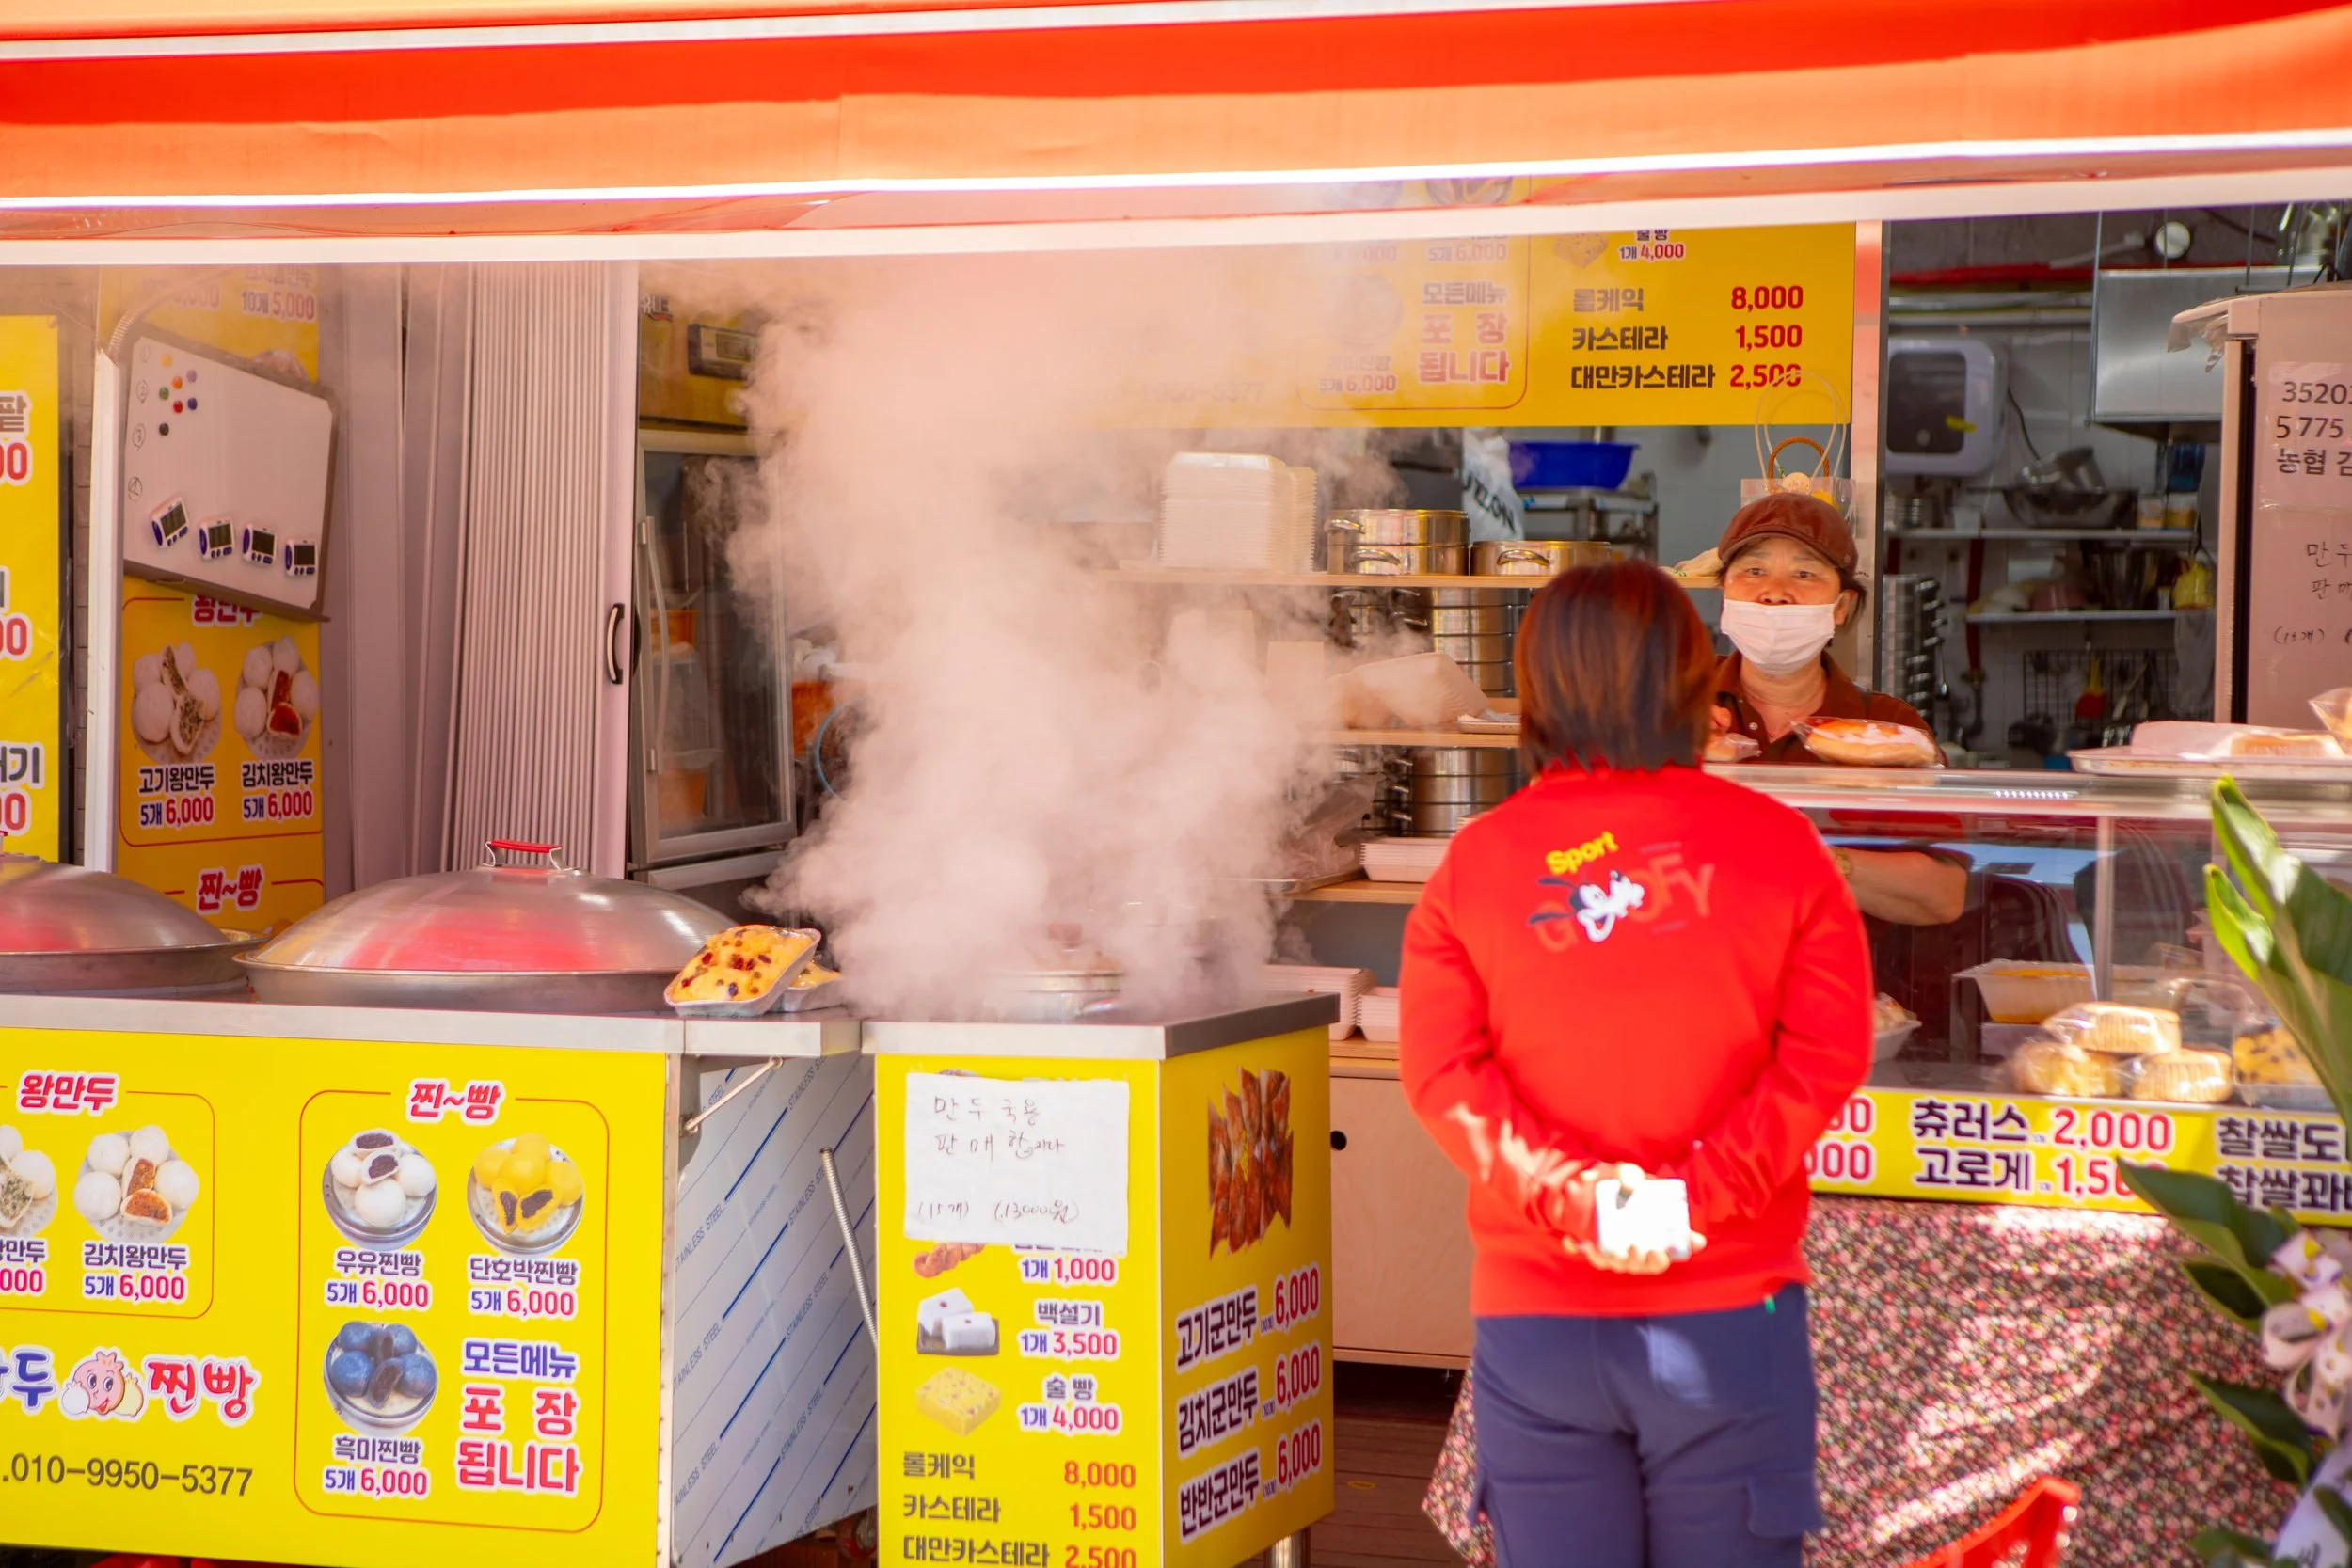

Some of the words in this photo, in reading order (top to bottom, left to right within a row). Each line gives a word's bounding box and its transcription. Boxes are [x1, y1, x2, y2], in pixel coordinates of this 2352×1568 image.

[1640, 244, 1685, 261] 4,000
[272, 292, 315, 321] 5,000
[1422, 283, 1506, 305] 모든메뉴
[1572, 288, 1645, 312] 롤케익
[1731, 285, 1804, 313] 8,000
[1572, 326, 1669, 352] 카스테라
[1735, 325, 1804, 352] 1,500
[1419, 351, 1510, 383] 됩니다
[1570, 364, 1716, 389] 대만카스테라
[1729, 363, 1803, 390] 2,500
[2277, 448, 2327, 476] 농협
[138, 764, 215, 794] 고기왕만두
[241, 760, 314, 788] 김치왕만두
[140, 804, 163, 826] 5개
[166, 796, 215, 829] 6,000
[243, 797, 264, 819] 5개
[267, 790, 313, 820] 6,000
[1545, 830, 1619, 876] Sport
[20, 1074, 118, 1112] 왕만두
[1914, 1100, 2028, 1142] 츄러스
[2054, 1106, 2170, 1151] 2,000
[1915, 1148, 2030, 1191] 고로게
[2218, 1165, 2352, 1212] 찹쌀꽈
[706, 1203, 726, 1234] STEEL
[0, 1239, 46, 1263] 만두
[83, 1243, 188, 1271] 김치왕만두
[336, 1249, 422, 1277] 우유찐빵
[469, 1257, 580, 1287] 단호박찐빵
[1022, 1259, 1049, 1280] 1개
[1054, 1258, 1116, 1282] 1,000
[85, 1275, 115, 1297] 5개
[119, 1273, 186, 1302] 6,000
[326, 1282, 358, 1305] 5개
[361, 1280, 430, 1309] 6,000
[470, 1291, 502, 1313] 5개
[506, 1289, 576, 1317] 6,000
[1037, 1302, 1102, 1327] 백설기
[1177, 1290, 1257, 1368] 고기군만두
[1275, 1266, 1319, 1327] 6,000
[703, 1322, 723, 1352] STEEL
[1021, 1333, 1048, 1354] 1개
[1053, 1331, 1118, 1356] 3,500
[463, 1340, 577, 1379] 모든메뉴
[0, 1352, 54, 1408] 두
[147, 1360, 255, 1419] 찐빵
[1178, 1370, 1259, 1453] 김치군만두
[1276, 1344, 1320, 1408] 6,000
[1020, 1406, 1048, 1428] 1개
[1052, 1404, 1120, 1431] 4,000
[335, 1435, 421, 1465] 흑미찐빵
[457, 1440, 580, 1493] 됩니다
[674, 1465, 701, 1512] AINLESS
[700, 1441, 720, 1470] STEEL
[902, 1450, 976, 1481] 롤케익
[1064, 1459, 1136, 1489] 8,000
[1181, 1452, 1260, 1538] 반반군만두
[1278, 1423, 1321, 1487] 6,000
[325, 1468, 356, 1491] 5개
[359, 1467, 428, 1497] 6,000
[902, 1493, 1002, 1524] 카스테라
[1069, 1502, 1137, 1532] 1,500
[902, 1535, 1051, 1568] 대만카스테라
[1064, 1544, 1137, 1568] 2,500
